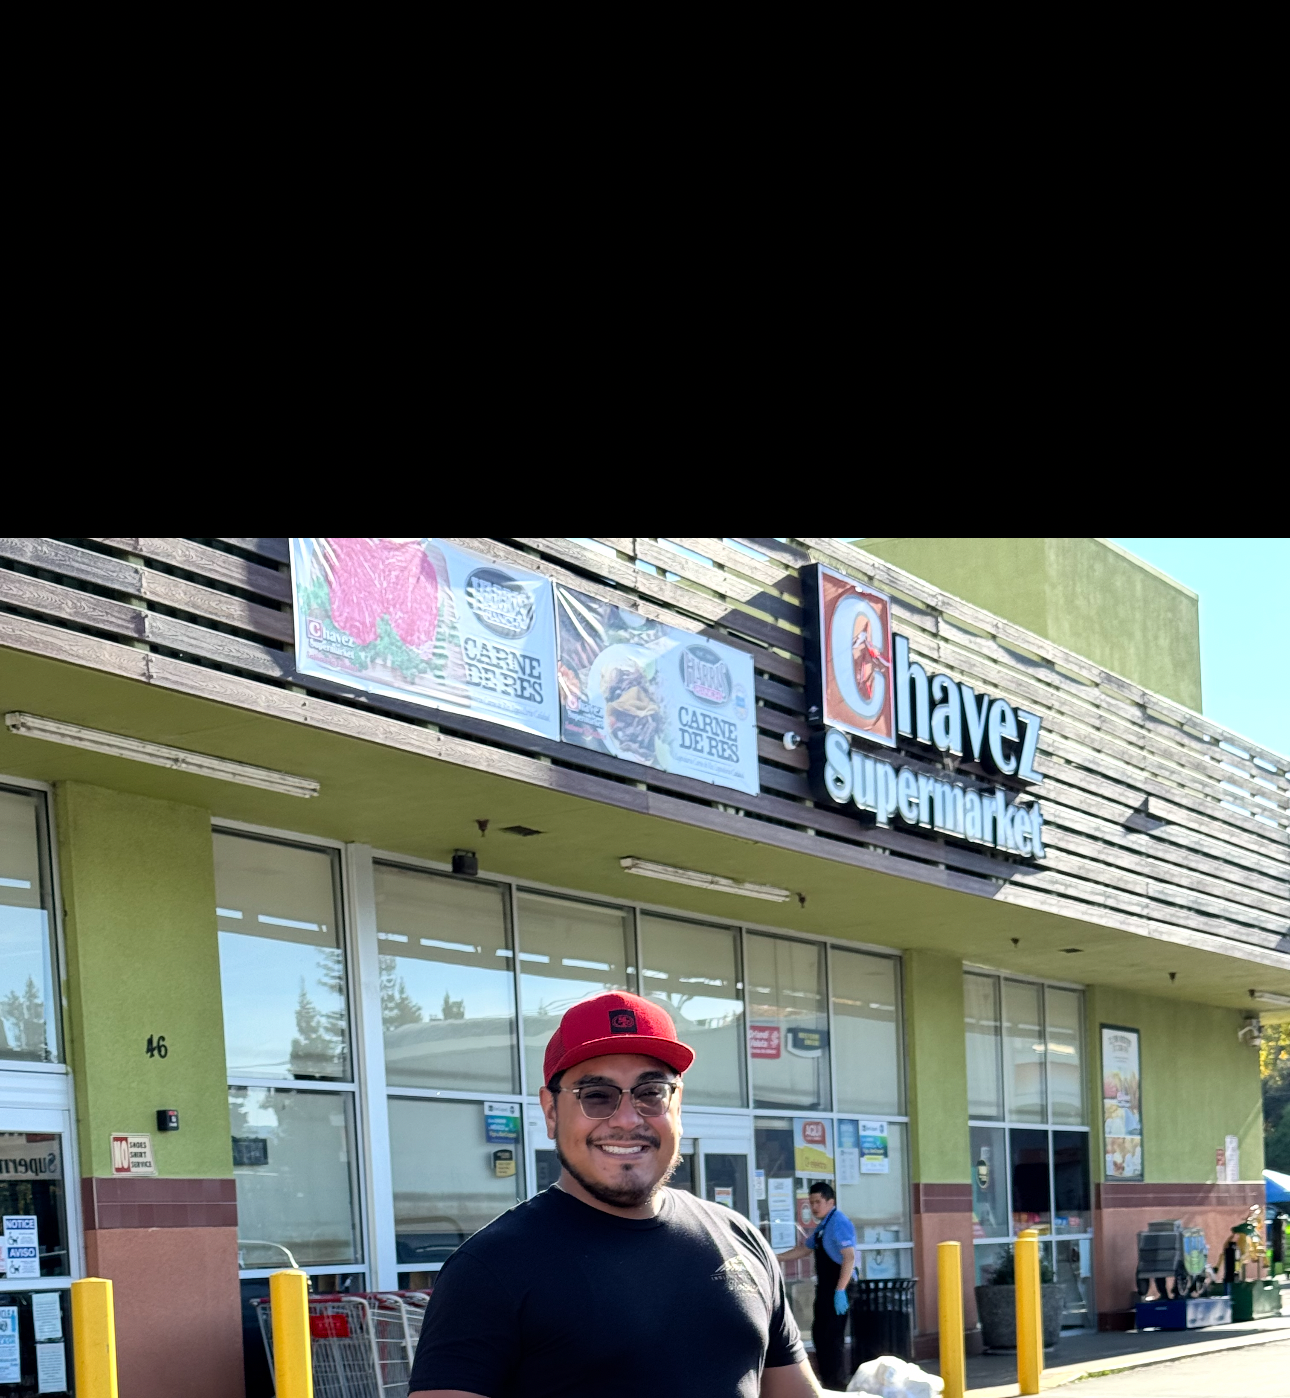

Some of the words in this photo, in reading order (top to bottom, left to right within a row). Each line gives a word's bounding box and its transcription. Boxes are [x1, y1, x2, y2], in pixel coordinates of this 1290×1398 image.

[309, 621, 355, 647] Chavez
[464, 637, 541, 681] CARNE
[465, 663, 497, 692] DE
[501, 672, 543, 704] RES
[831, 594, 1044, 786] Chavez
[678, 706, 737, 743] CARNE
[679, 728, 704, 753] DE
[707, 736, 739, 763] RES
[824, 728, 1046, 860] Supermarket
[145, 1033, 168, 1059] 46
[113, 1140, 129, 1169] NO
[6, 1220, 35, 1229] NOTICE
[9, 1248, 36, 1257] AVISO
